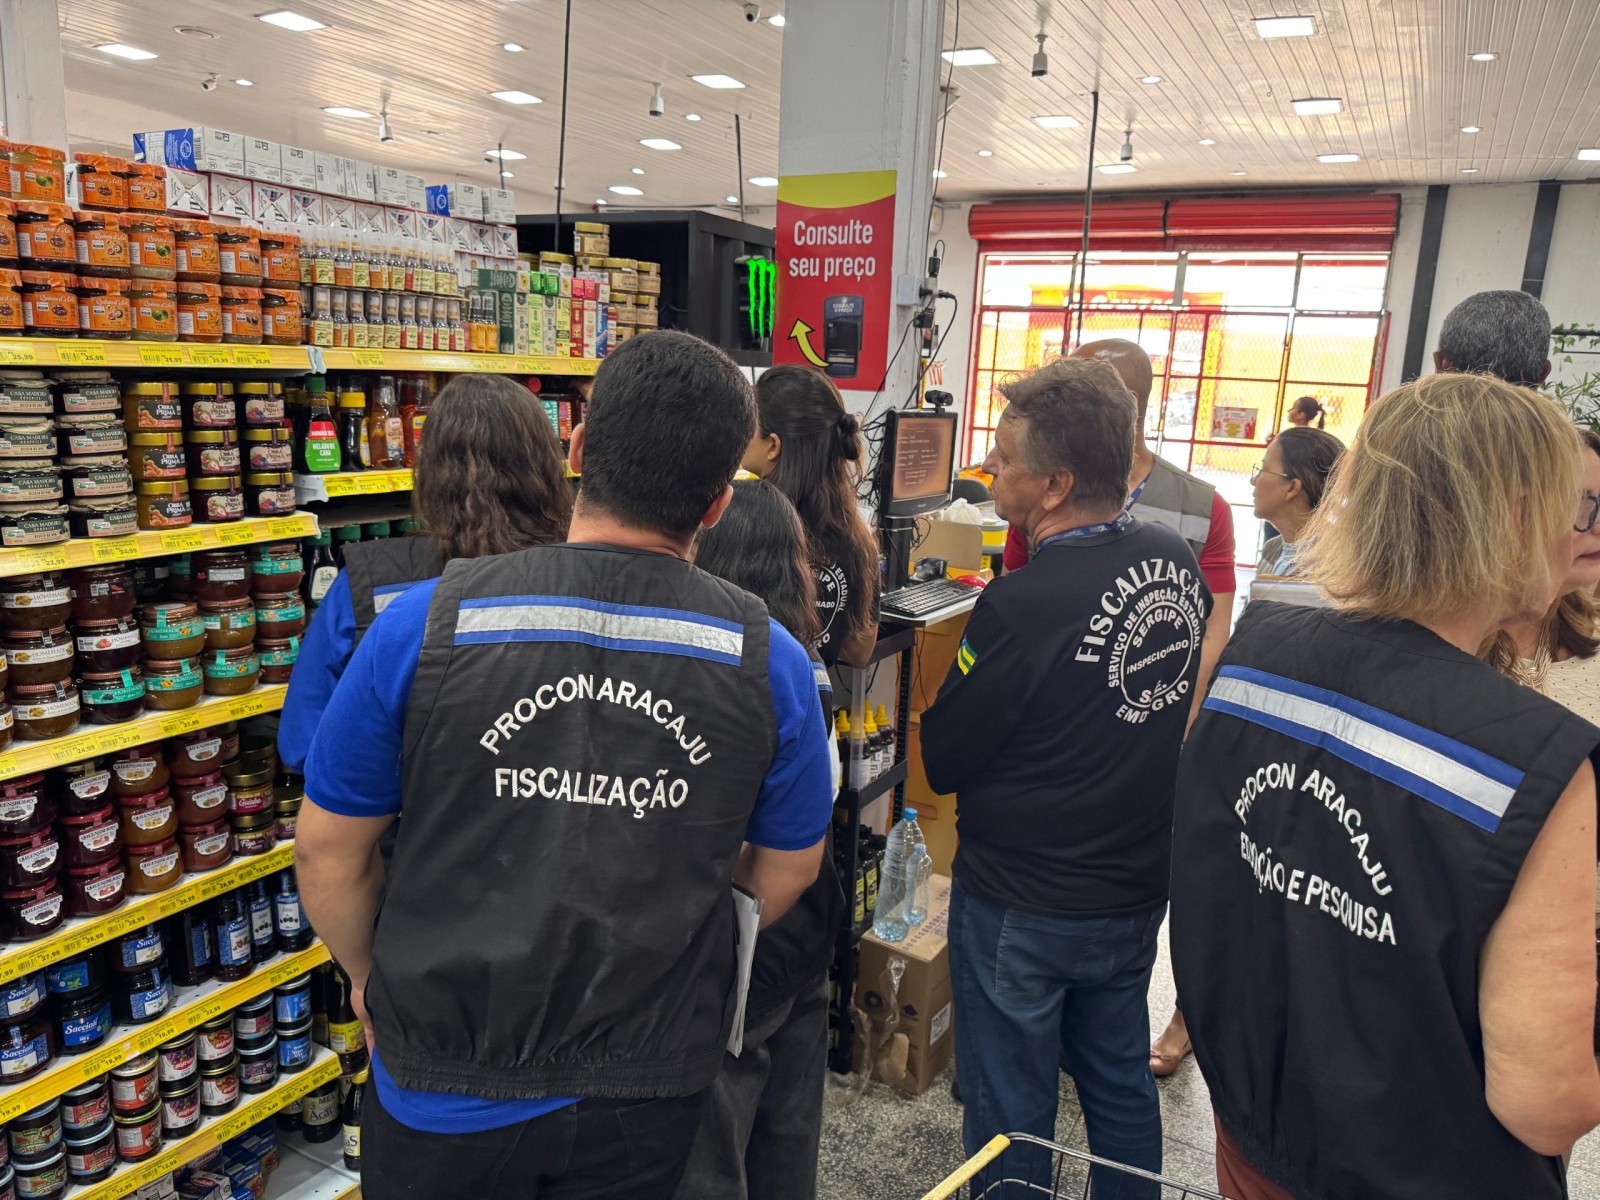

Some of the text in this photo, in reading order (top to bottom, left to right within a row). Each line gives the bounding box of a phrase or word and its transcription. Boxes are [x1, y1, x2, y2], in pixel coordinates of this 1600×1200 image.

[794, 220, 874, 246] Consulte
[789, 256, 876, 282] seu preço
[835, 568, 848, 612] ESTADUAL
[1108, 587, 1201, 688] SERVIÇO DE INSPEÇÃO ESTADUAL
[1132, 607, 1183, 648] SERGIPE
[1115, 680, 1189, 724] EMDGRO
[479, 674, 712, 765] PROCON ARACAJU
[77, 745, 96, 754] 24,99
[123, 735, 141, 743] 27,99
[495, 767, 689, 818] FISCALIZAÇÃO
[1234, 762, 1393, 896] PROCON ARACAJU
[240, 840, 256, 849] Figo
[1286, 869, 1305, 901] E
[1304, 874, 1397, 946] PESQUISA
[128, 916, 145, 926] 28,99
[86, 933, 104, 943] 28,99
[41, 950, 60, 961] 27,99
[206, 1006, 221, 1015] 22,99
[105, 1055, 122, 1066] 19,99
[2, 1104, 21, 1117] 19,99
